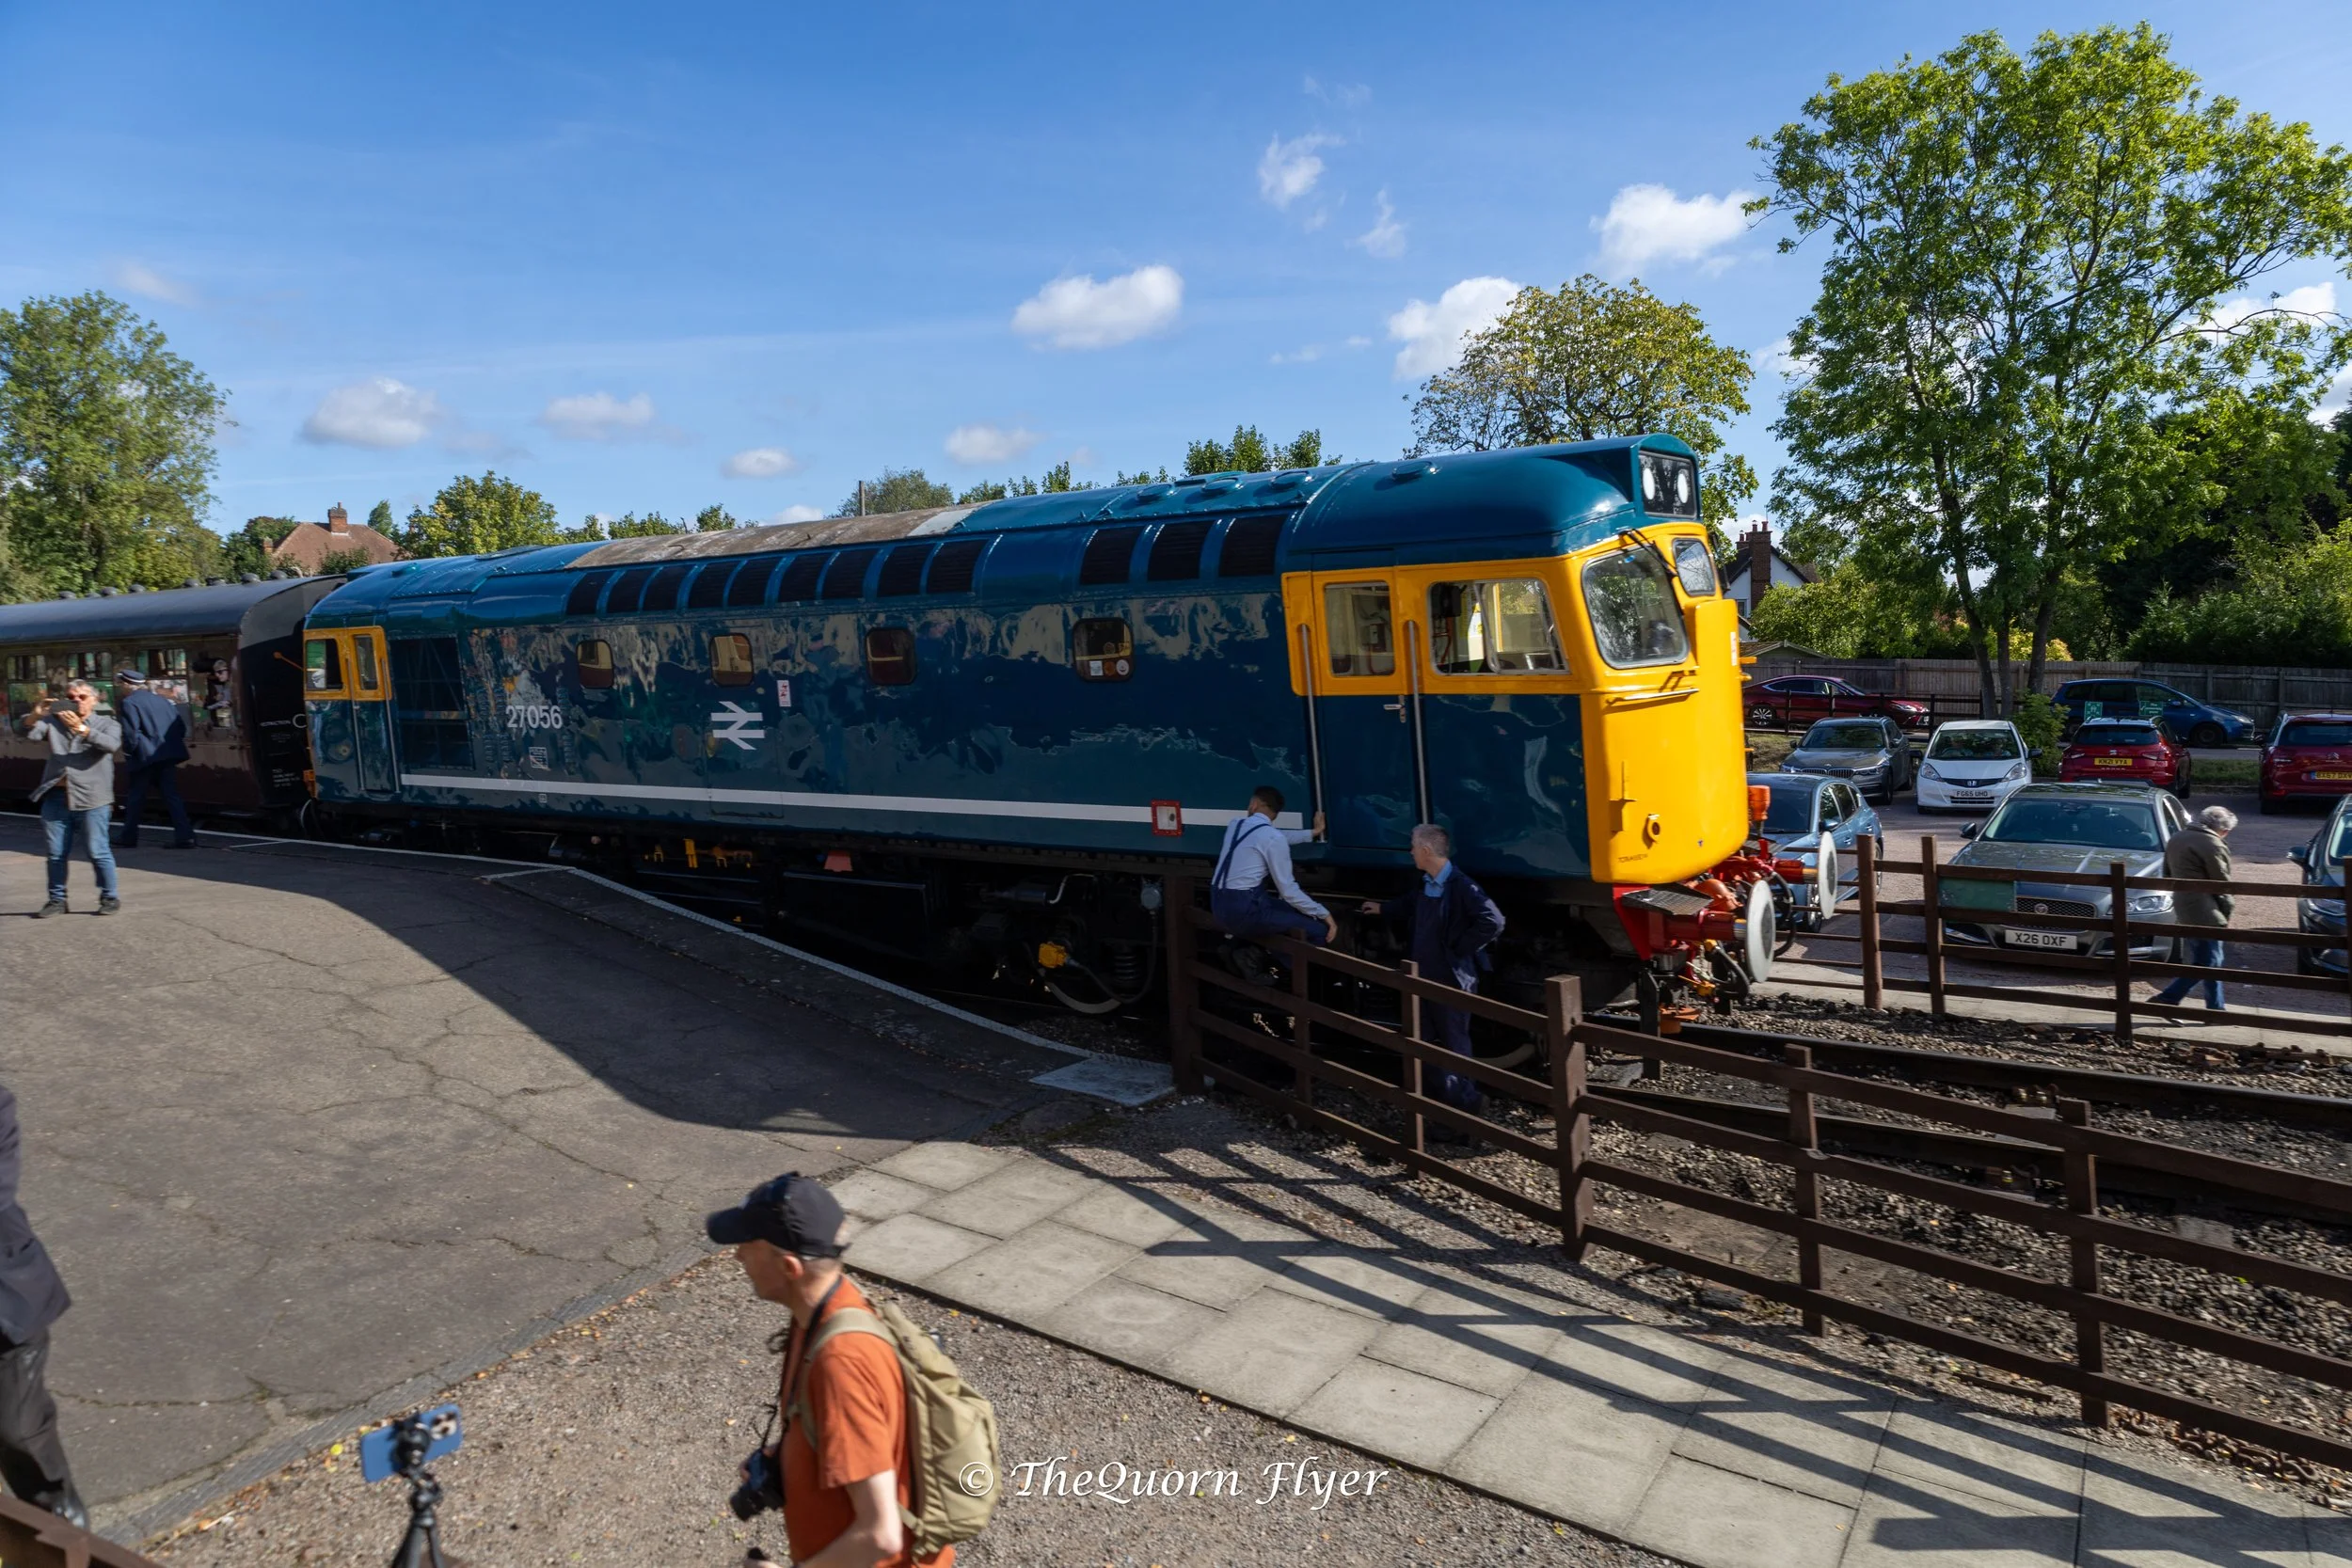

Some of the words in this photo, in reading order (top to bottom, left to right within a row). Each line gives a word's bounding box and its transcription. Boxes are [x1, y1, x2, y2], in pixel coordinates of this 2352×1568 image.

[505, 705, 564, 729] 27056
[2015, 932, 2040, 944] X26
[2042, 935, 2067, 946] OXF
